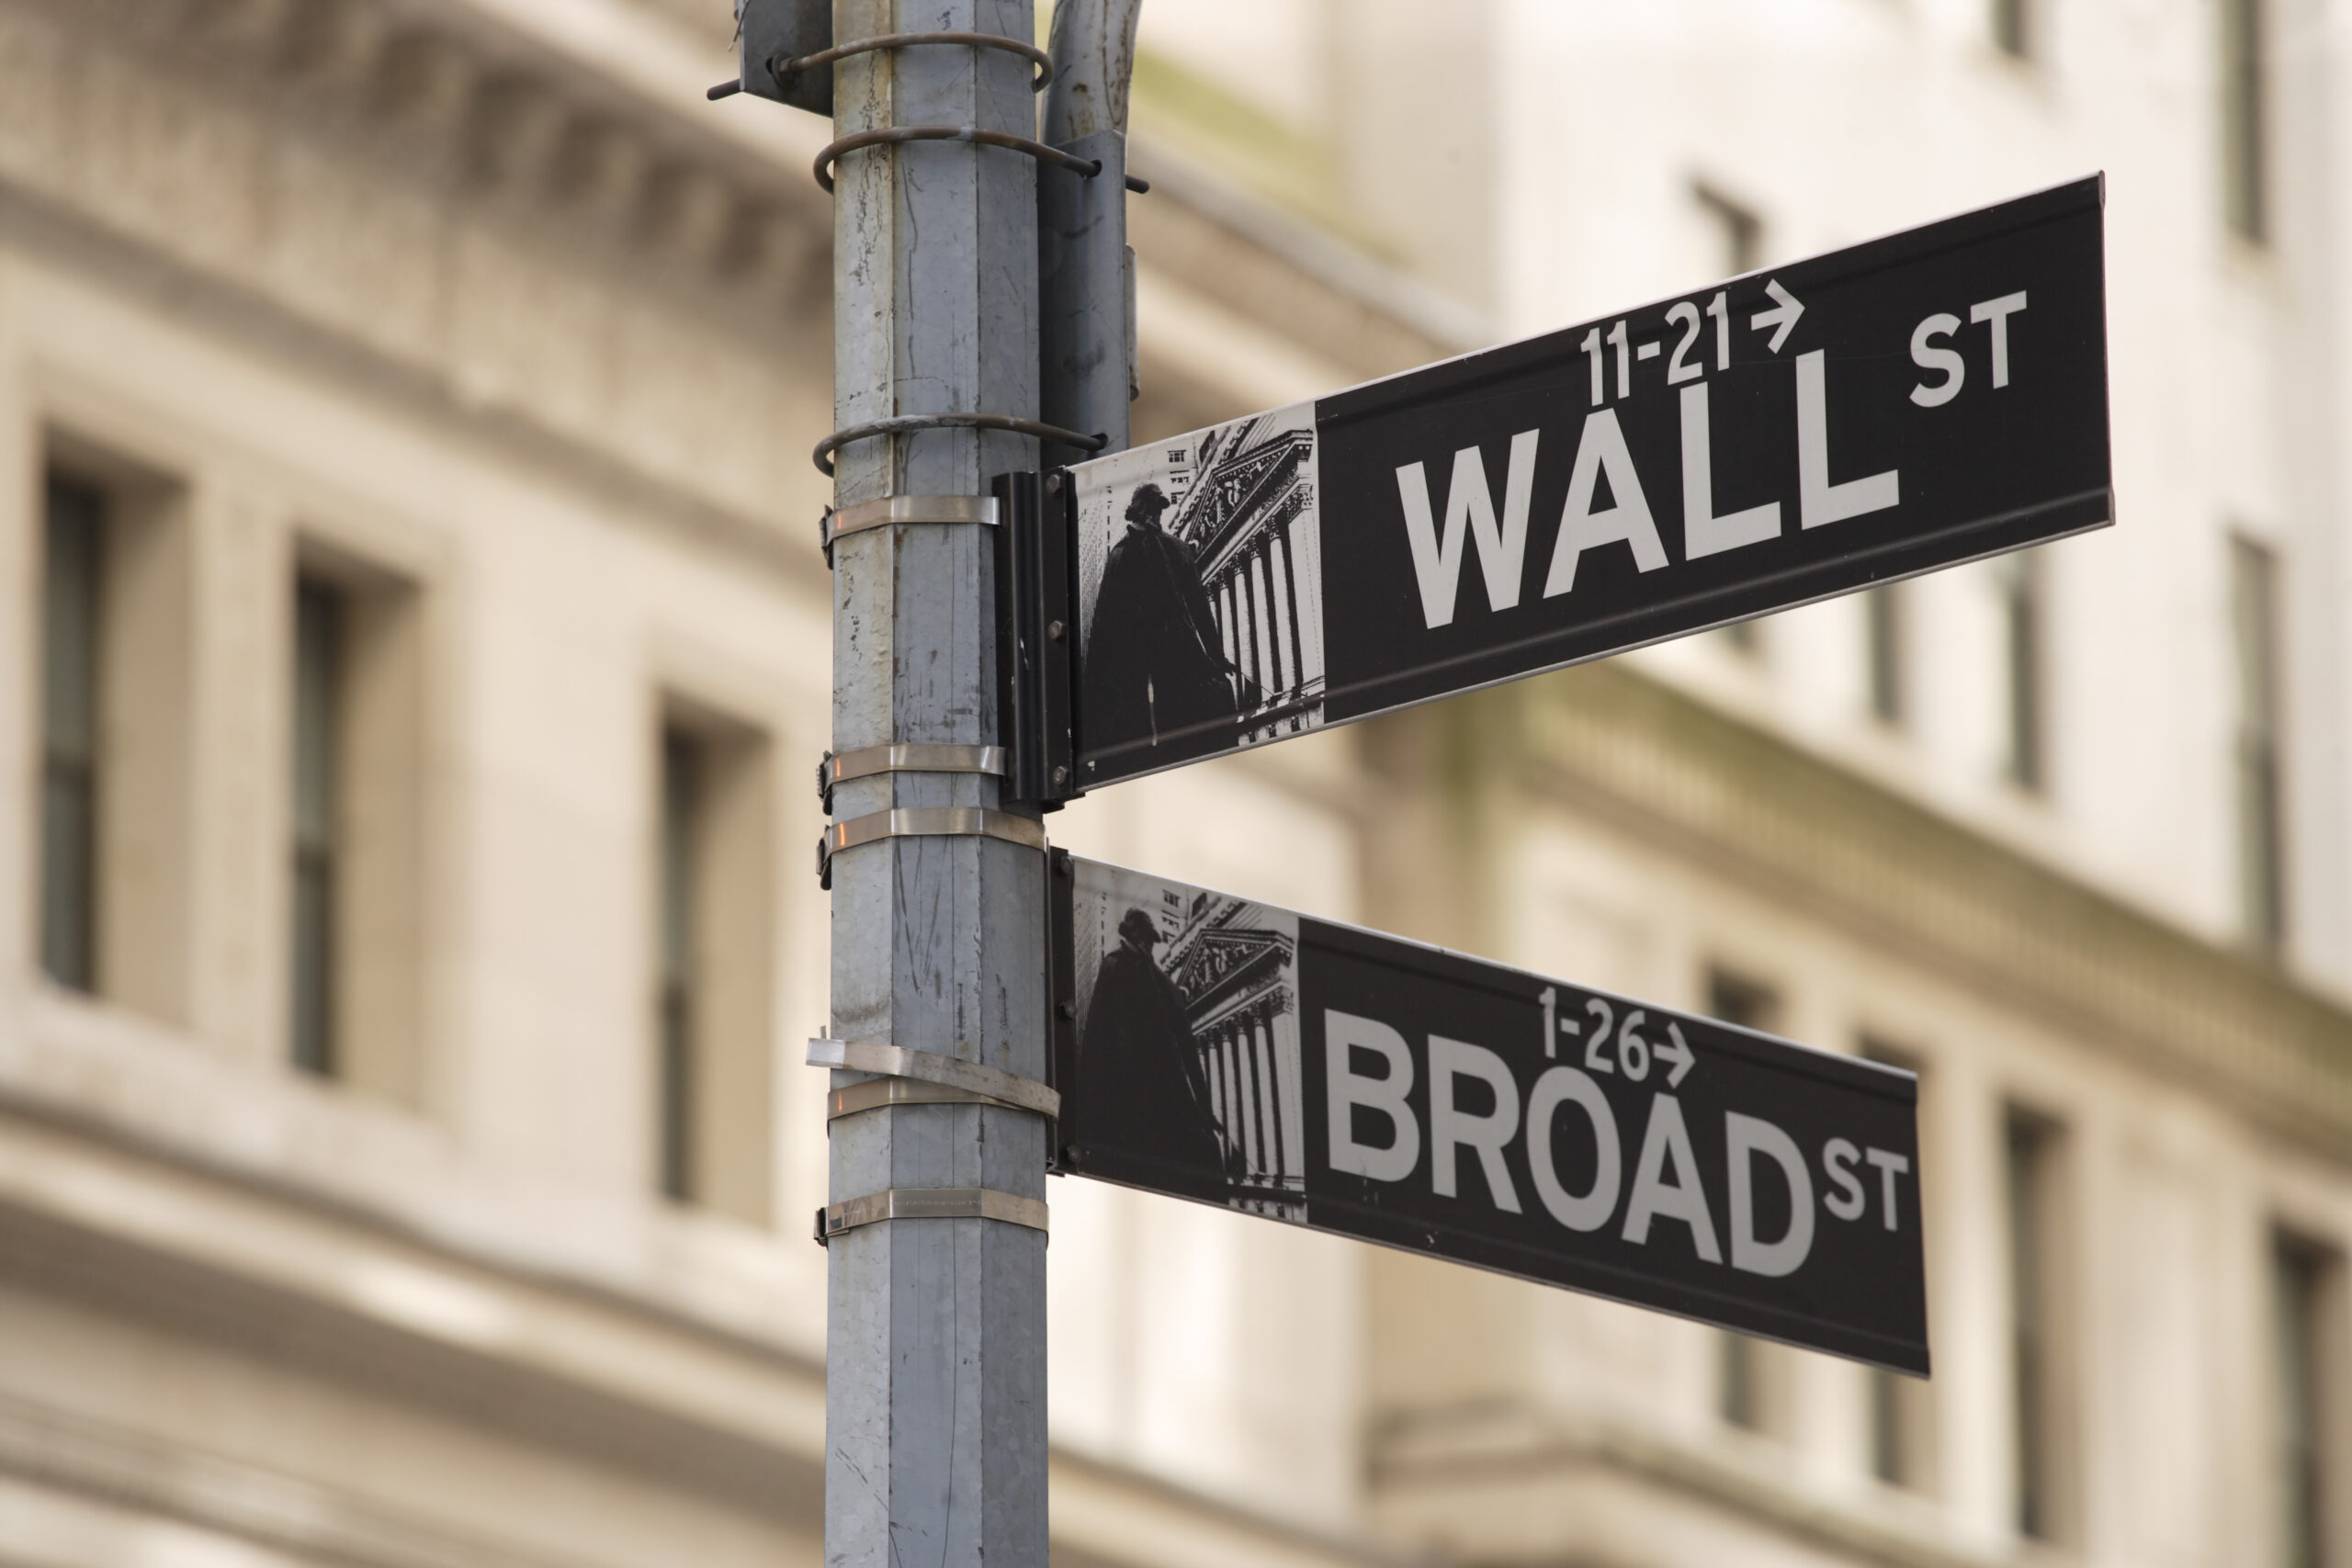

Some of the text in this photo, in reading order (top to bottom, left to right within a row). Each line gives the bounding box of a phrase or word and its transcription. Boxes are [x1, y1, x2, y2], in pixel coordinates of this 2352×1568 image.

[1580, 291, 1731, 407] 11-21
[1395, 290, 2027, 630] WALL ST
[1538, 987, 1649, 1083] 1-26
[1324, 1009, 1909, 1278] BROAD ST
